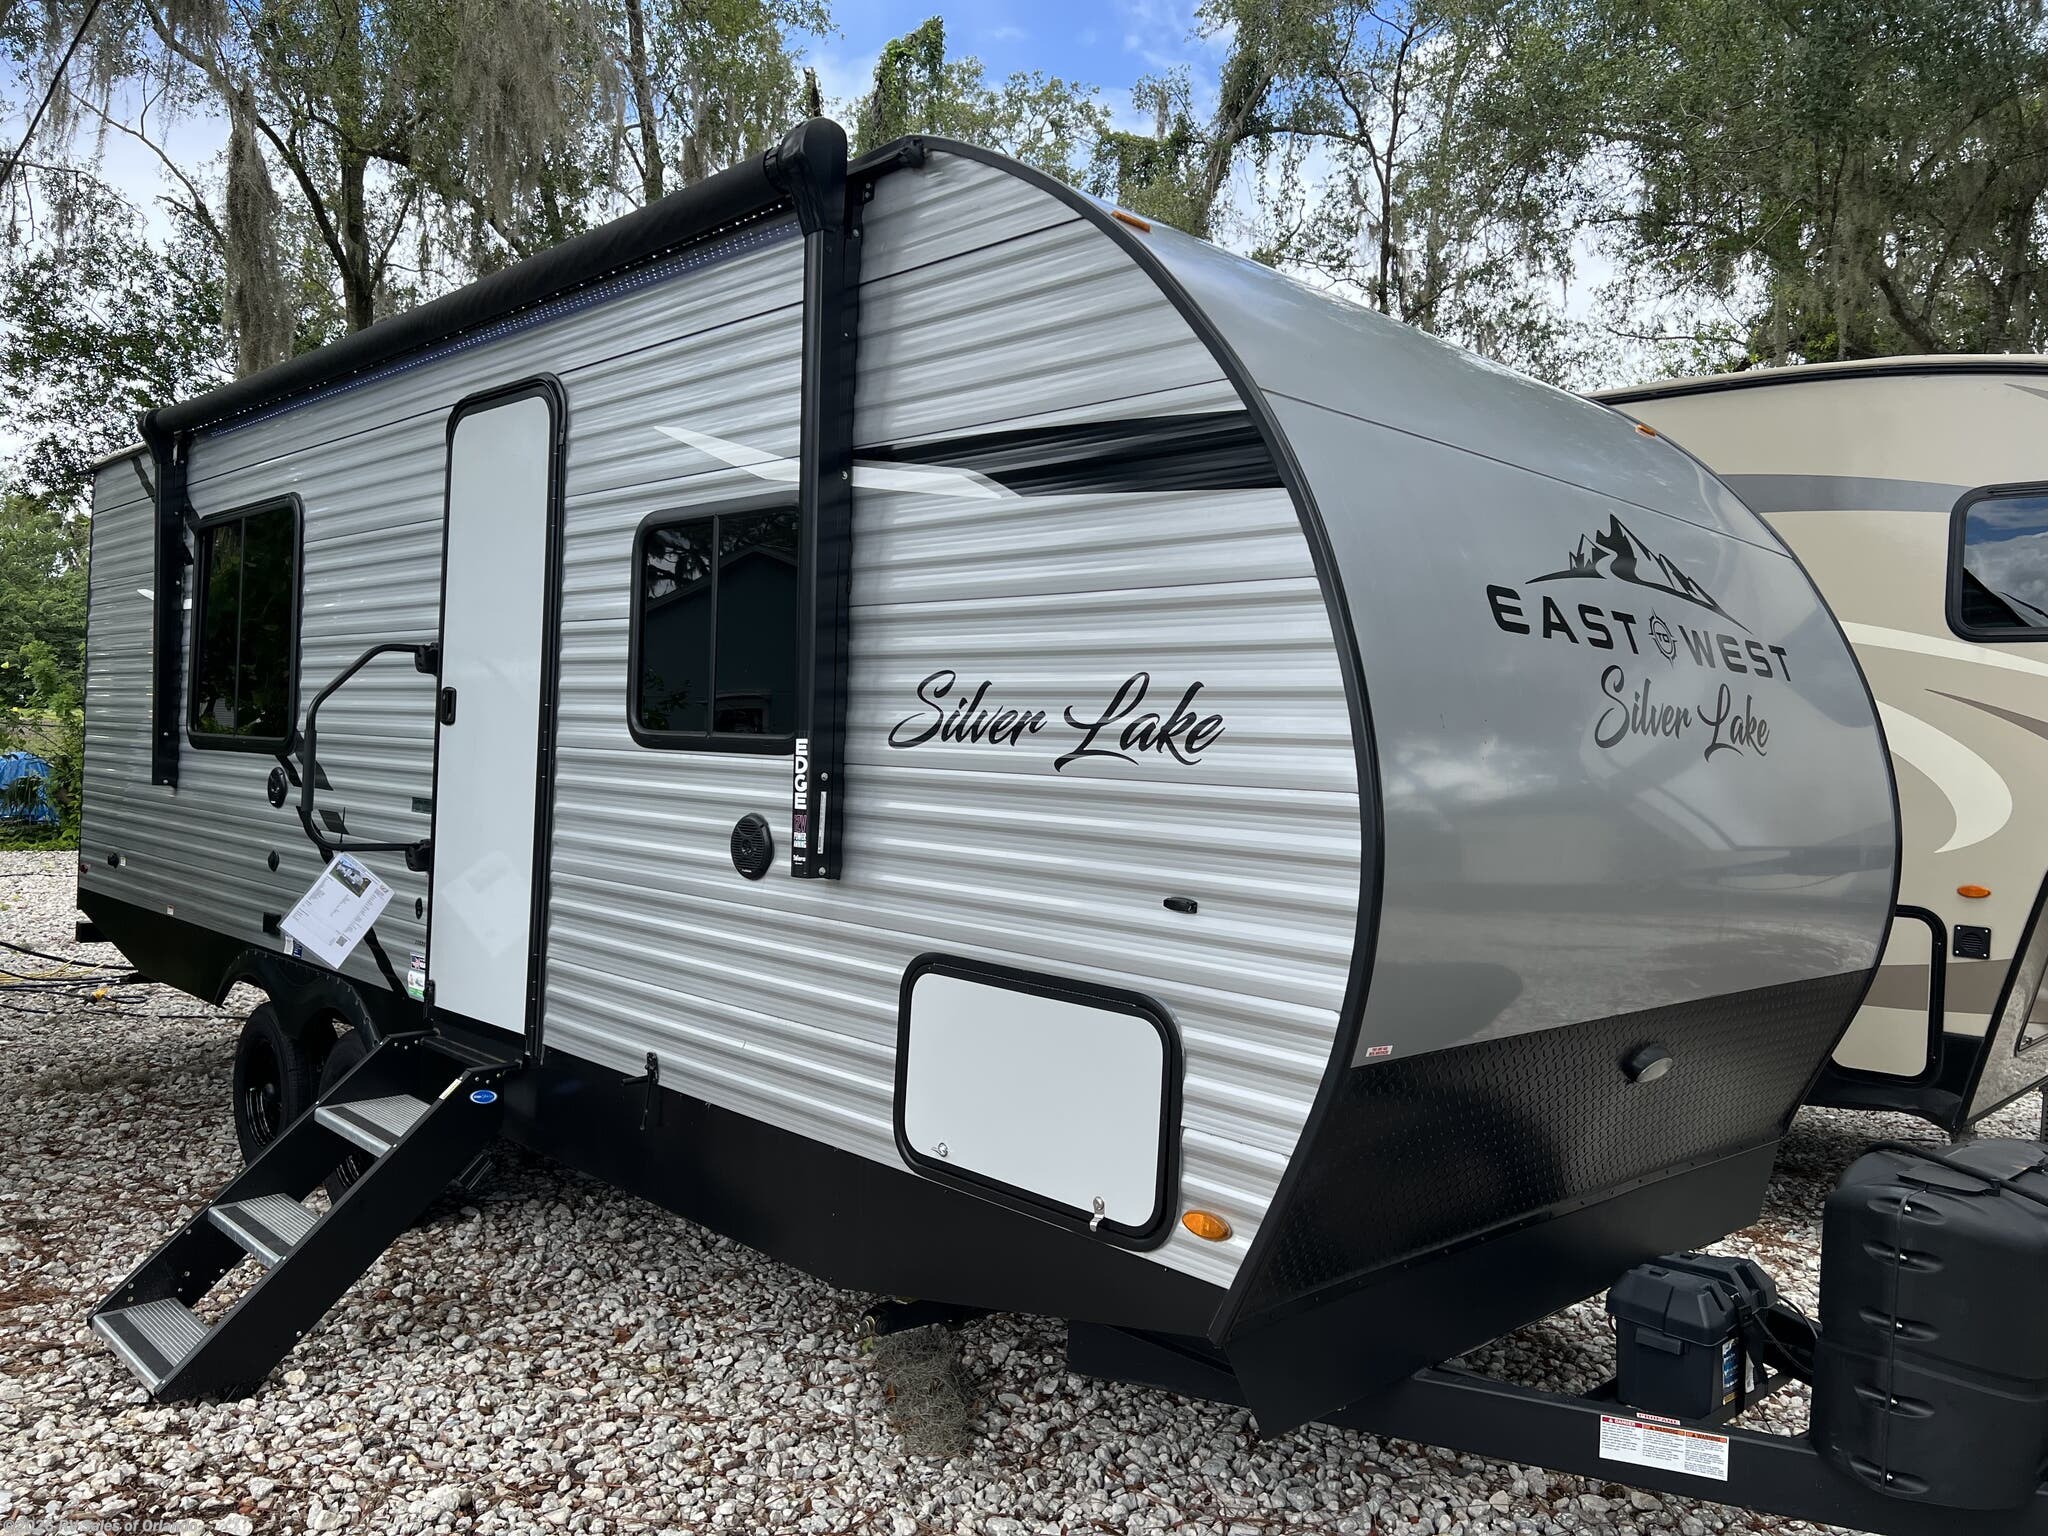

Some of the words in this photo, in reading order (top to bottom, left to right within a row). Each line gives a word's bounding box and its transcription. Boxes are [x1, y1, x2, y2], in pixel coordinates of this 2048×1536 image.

[1486, 584, 1639, 655] EAST
[1678, 624, 1791, 682] WEST
[888, 669, 1048, 749] Silver
[1053, 671, 1226, 773] Lake
[1594, 664, 1692, 749] Silver
[1696, 683, 1770, 762] Lake
[794, 738, 809, 810] EDGE
